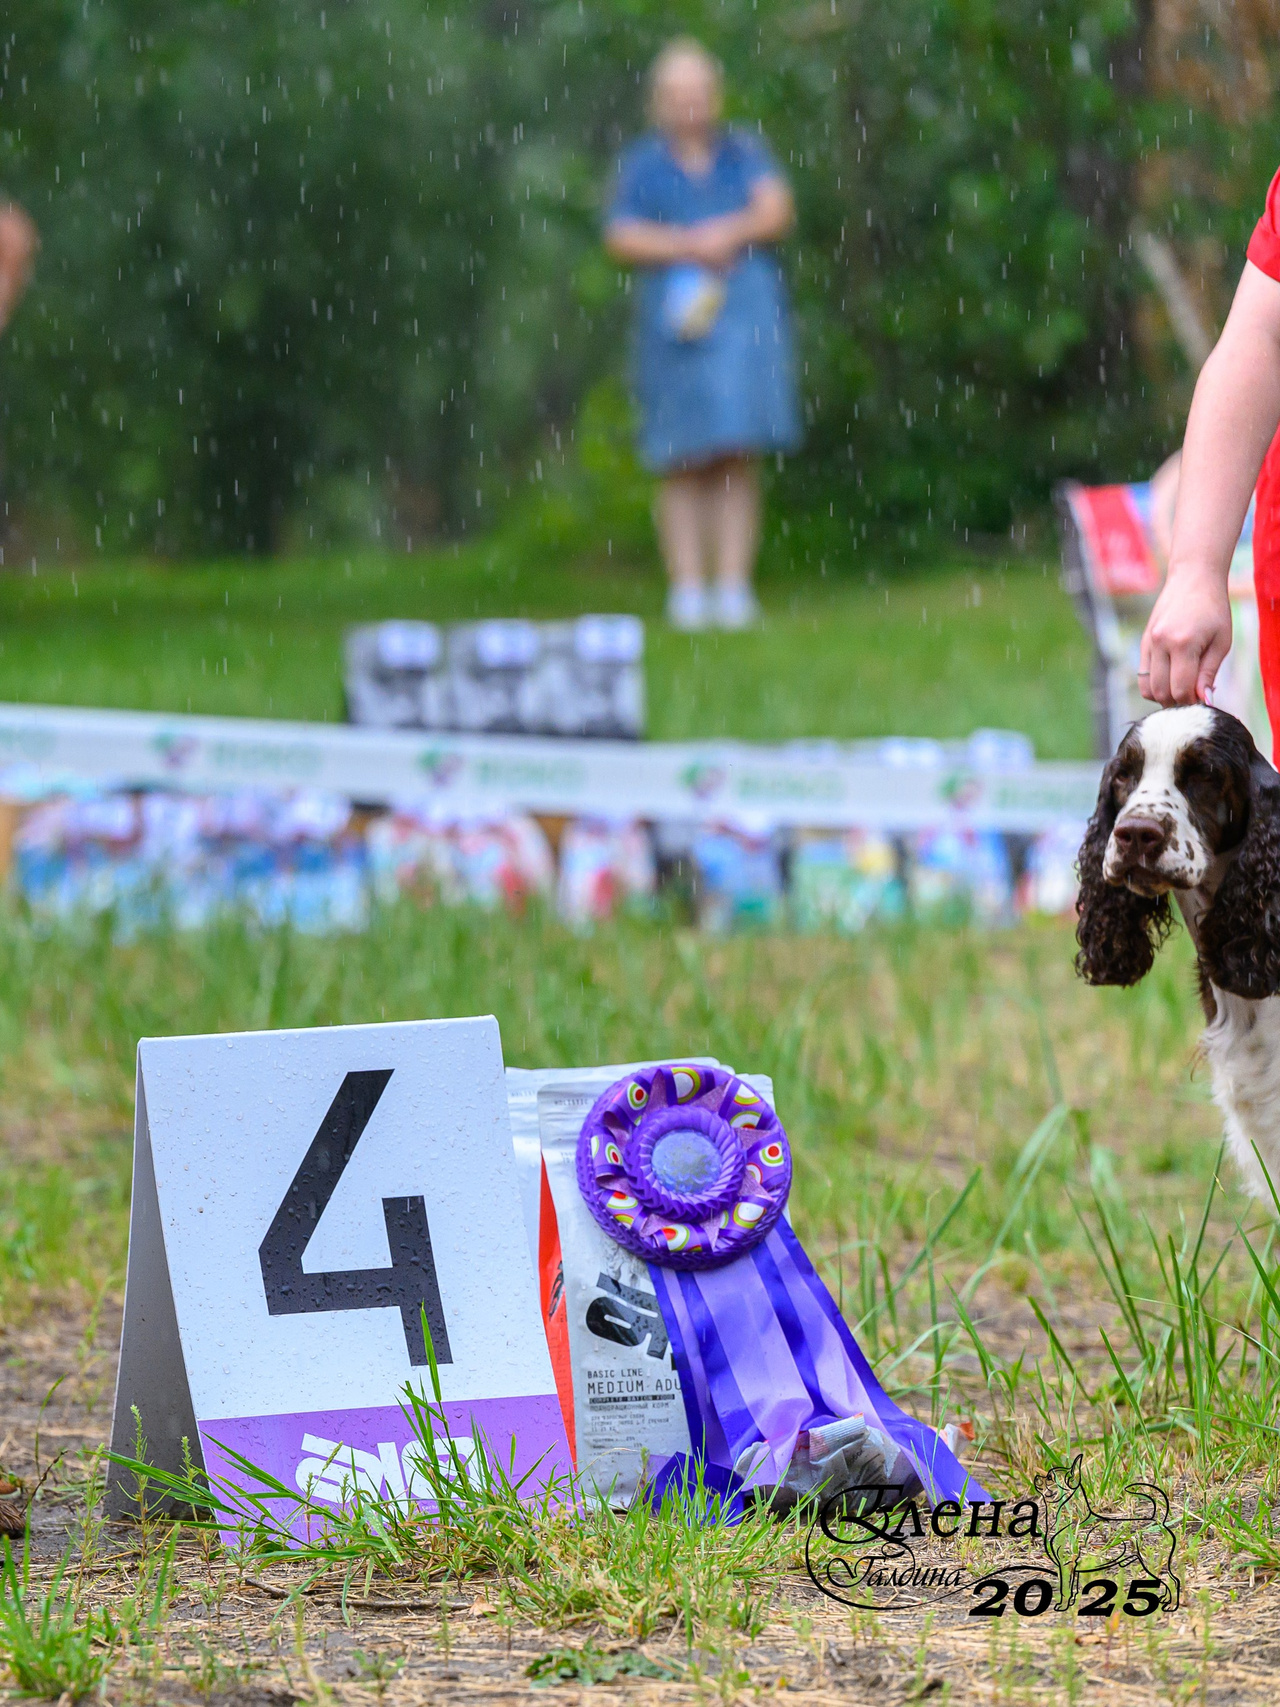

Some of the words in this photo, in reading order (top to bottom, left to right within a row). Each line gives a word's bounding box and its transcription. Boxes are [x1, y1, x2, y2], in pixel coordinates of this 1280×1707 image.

[258, 1068, 454, 1367] 4
[587, 1369, 615, 1379] BASIC
[621, 1368, 643, 1378] LINE
[587, 1380, 644, 1395] MEDIUM
[655, 1378, 682, 1392] ADU
